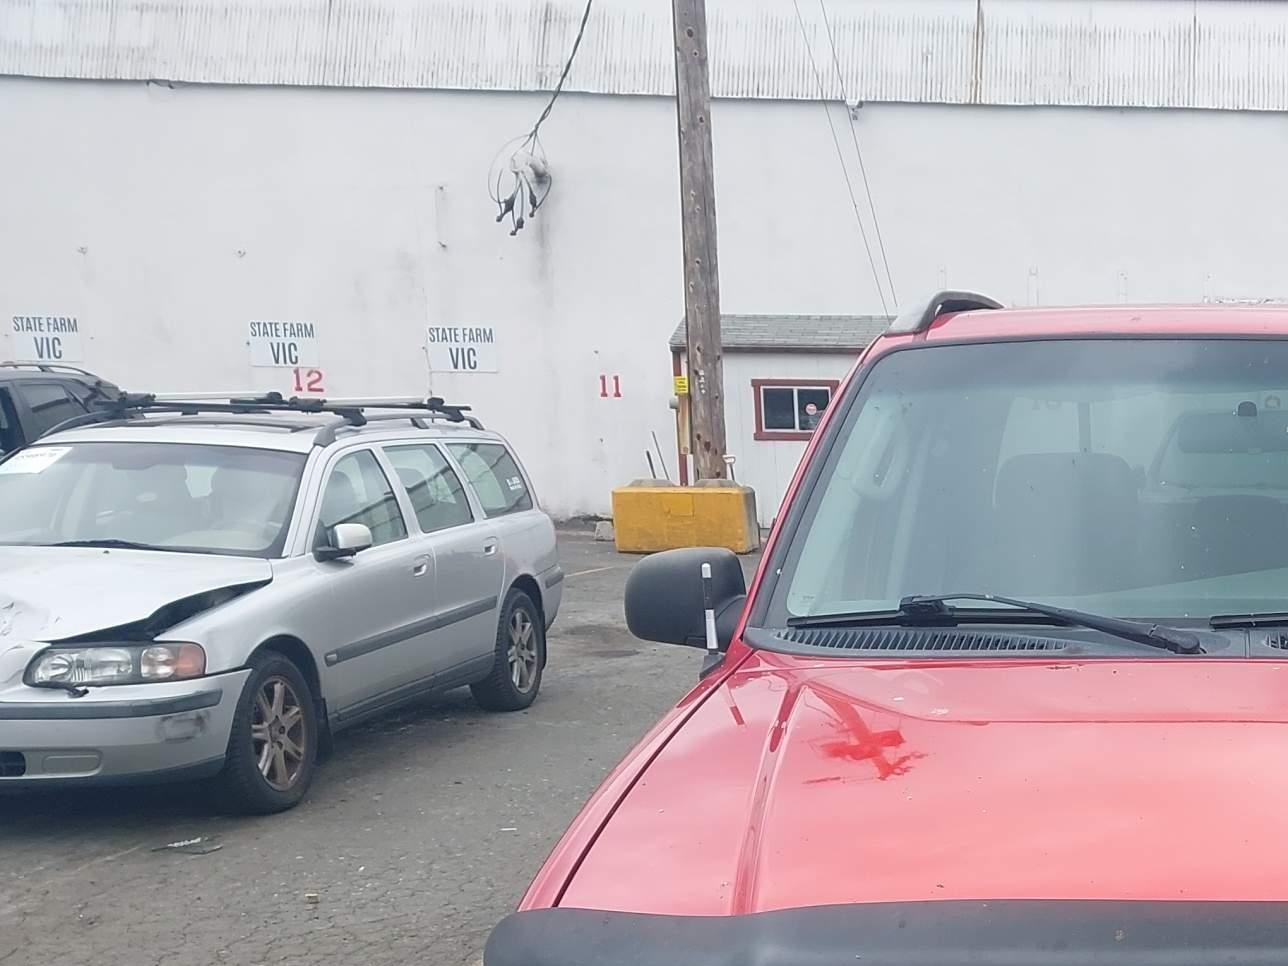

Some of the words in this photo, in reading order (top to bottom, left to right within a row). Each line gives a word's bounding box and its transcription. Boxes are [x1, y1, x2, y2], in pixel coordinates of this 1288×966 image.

[13, 316, 43, 332] STATE
[46, 317, 78, 333] FARM
[250, 321, 281, 338] STATE
[284, 322, 315, 338] FARM
[428, 327, 459, 343] STATE
[462, 327, 494, 343] FARM
[34, 337, 63, 359] VIC
[270, 342, 299, 365] VIC
[449, 347, 477, 370] VIC
[293, 367, 324, 392] 12
[600, 374, 622, 397] 11
